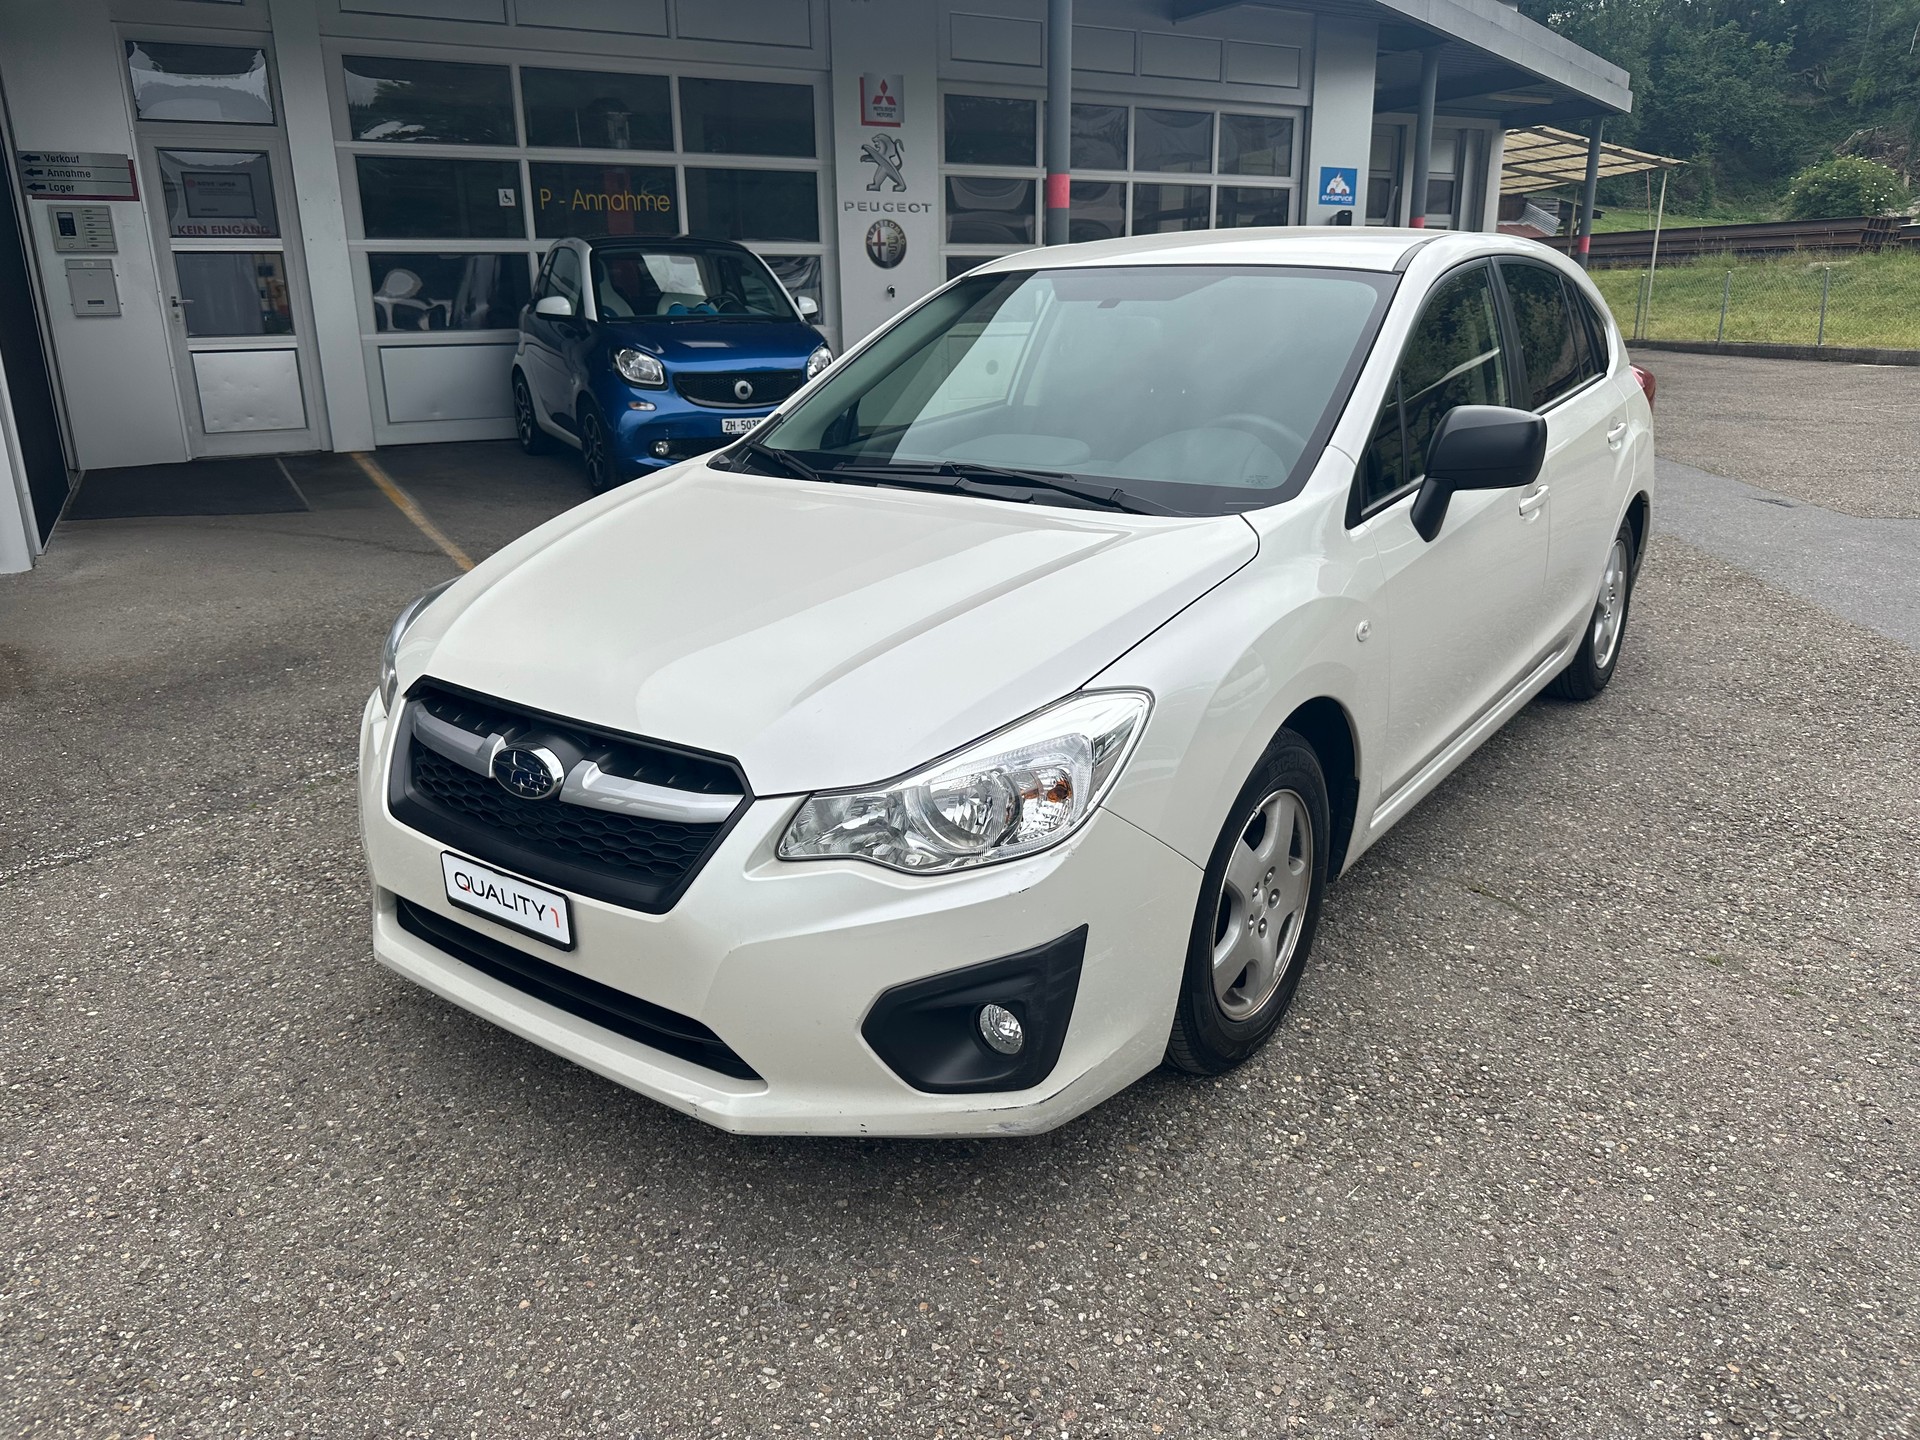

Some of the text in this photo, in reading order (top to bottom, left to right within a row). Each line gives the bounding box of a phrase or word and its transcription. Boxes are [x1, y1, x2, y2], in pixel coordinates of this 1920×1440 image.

[47, 168, 91, 178] Annahme
[49, 183, 74, 193] Lager
[540, 188, 551, 210] P
[572, 189, 670, 212] Annahme
[844, 201, 932, 213] PEUGEOT
[178, 225, 271, 236] KEIN EINGANG
[454, 871, 559, 928] QUALITY 1
